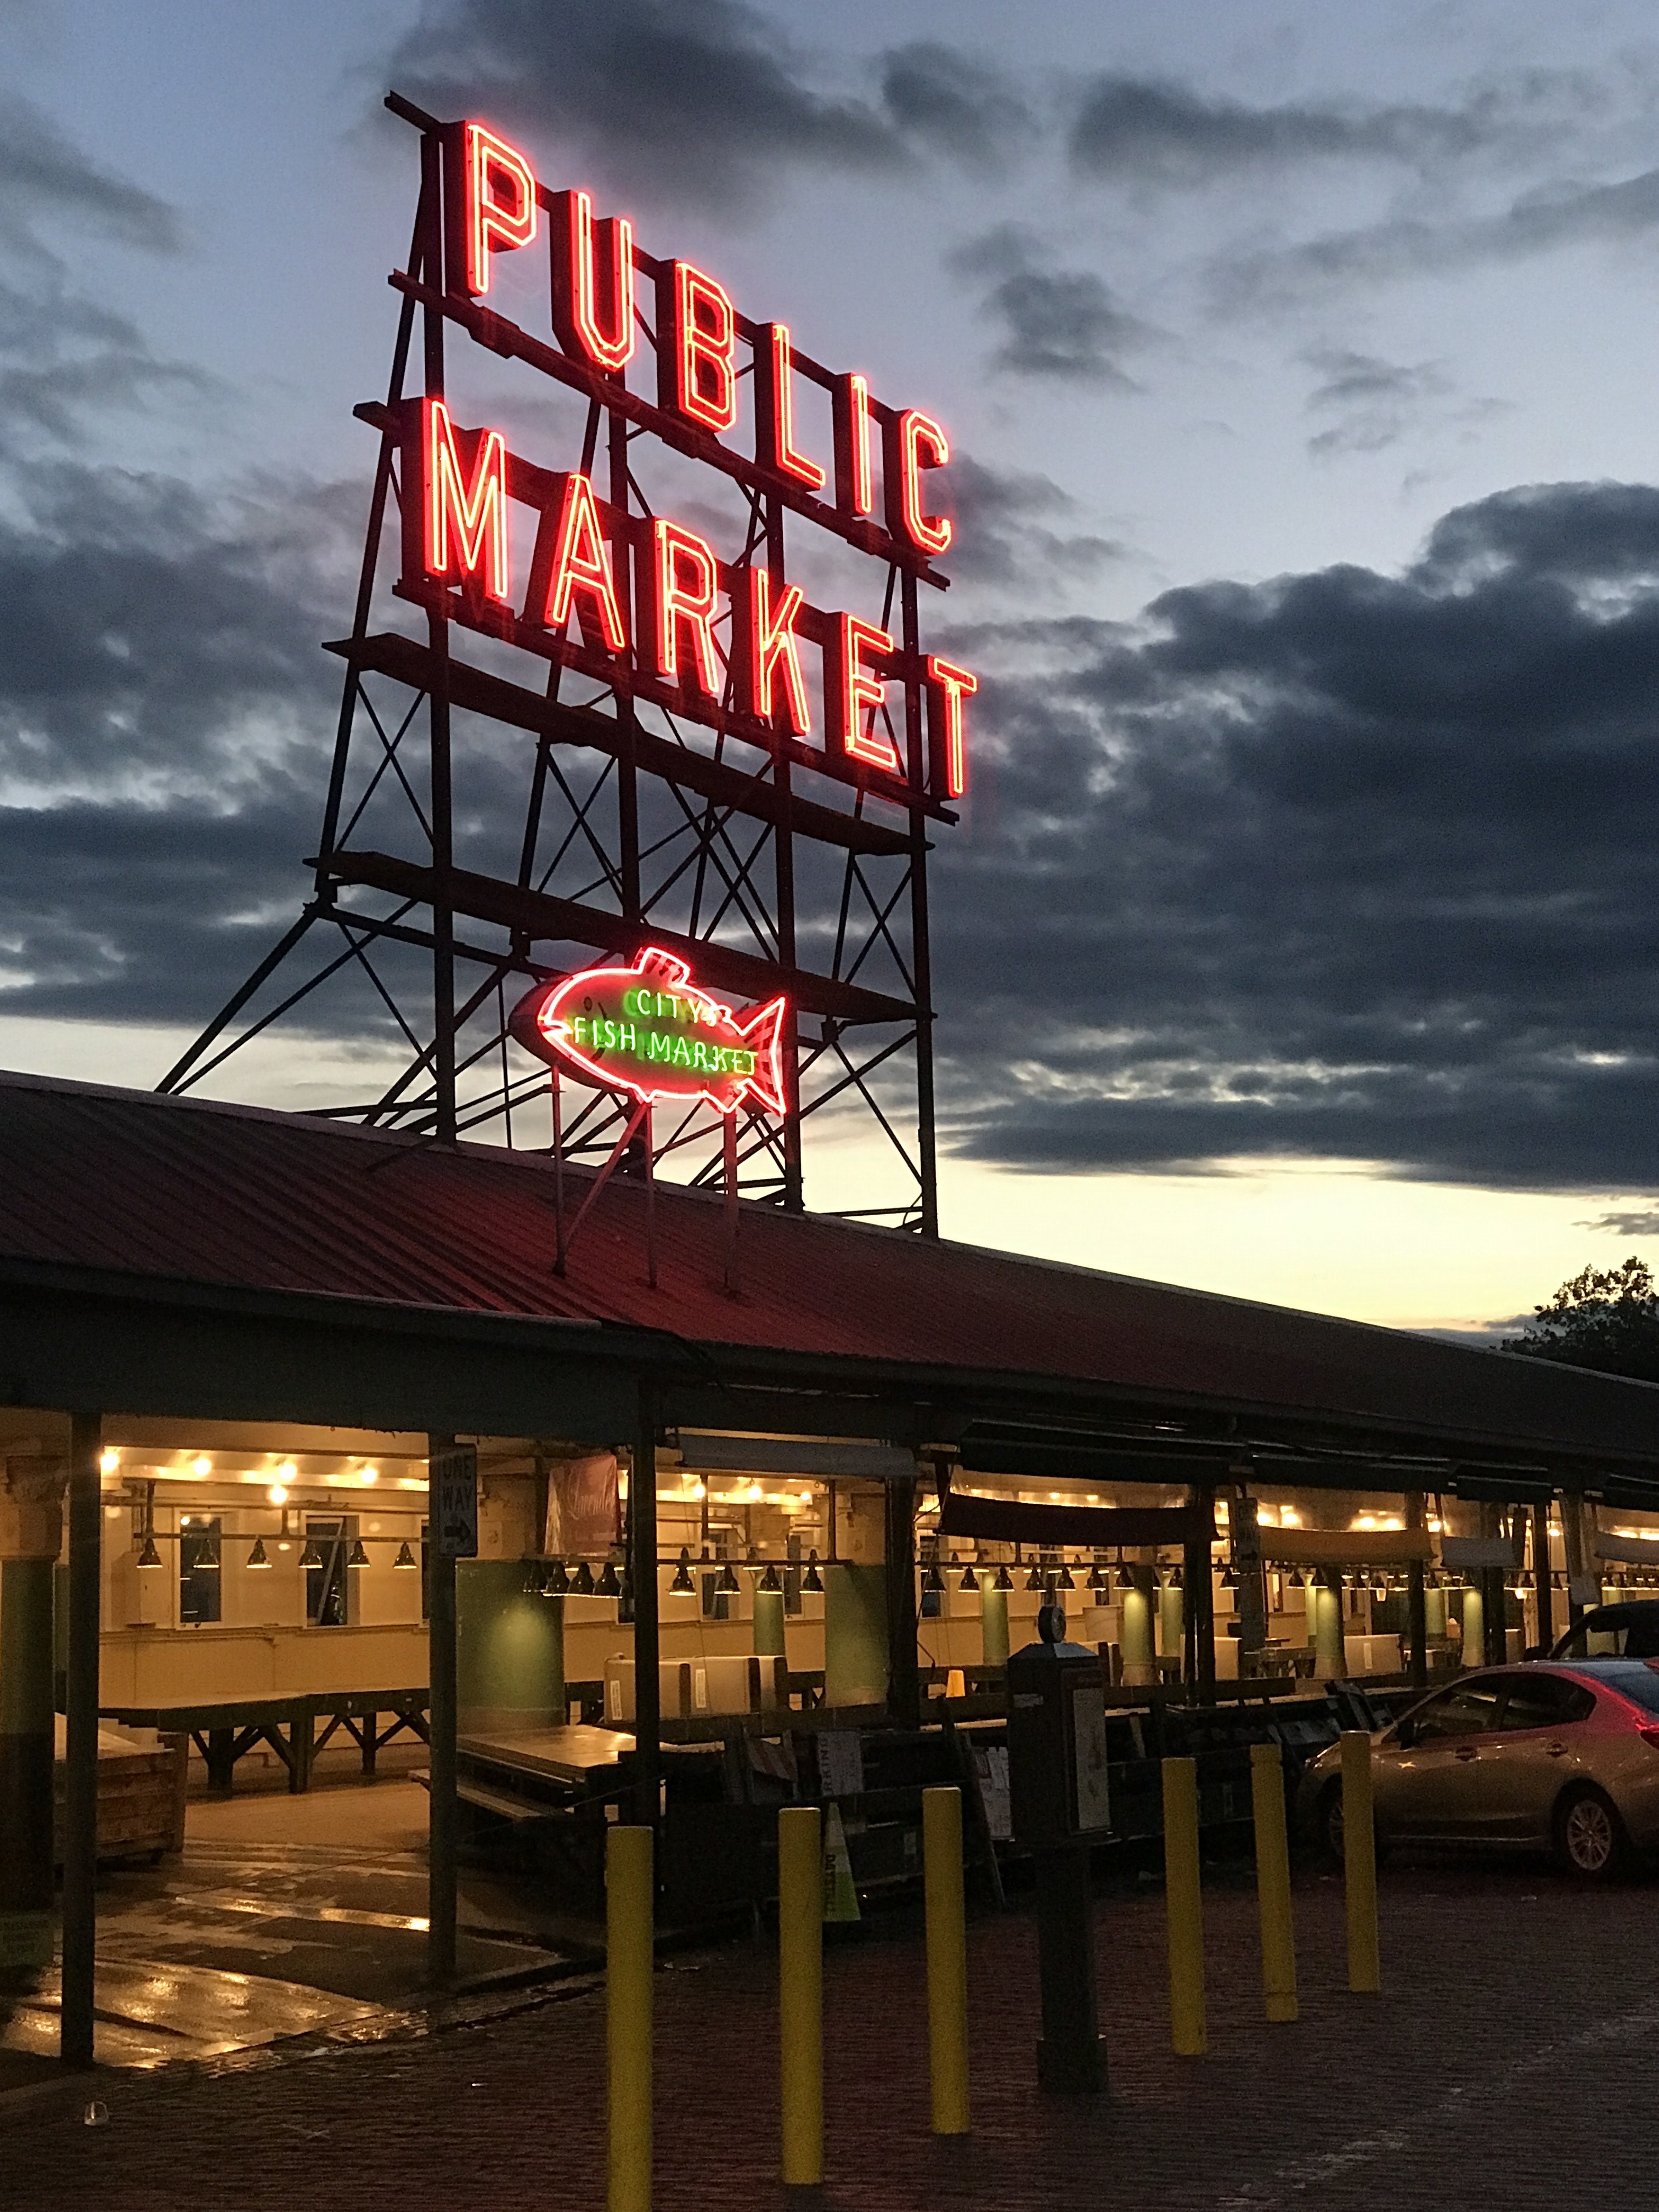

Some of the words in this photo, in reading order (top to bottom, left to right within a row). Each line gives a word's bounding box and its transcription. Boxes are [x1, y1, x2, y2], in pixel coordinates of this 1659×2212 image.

[466, 124, 952, 554] PUBLIC
[423, 396, 977, 799] MARKET
[637, 989, 703, 1024] CITY
[574, 1017, 636, 1051] FISH
[647, 1031, 758, 1075] MARKET
[443, 1455, 472, 1480] ONE
[442, 1485, 472, 1511] WAY
